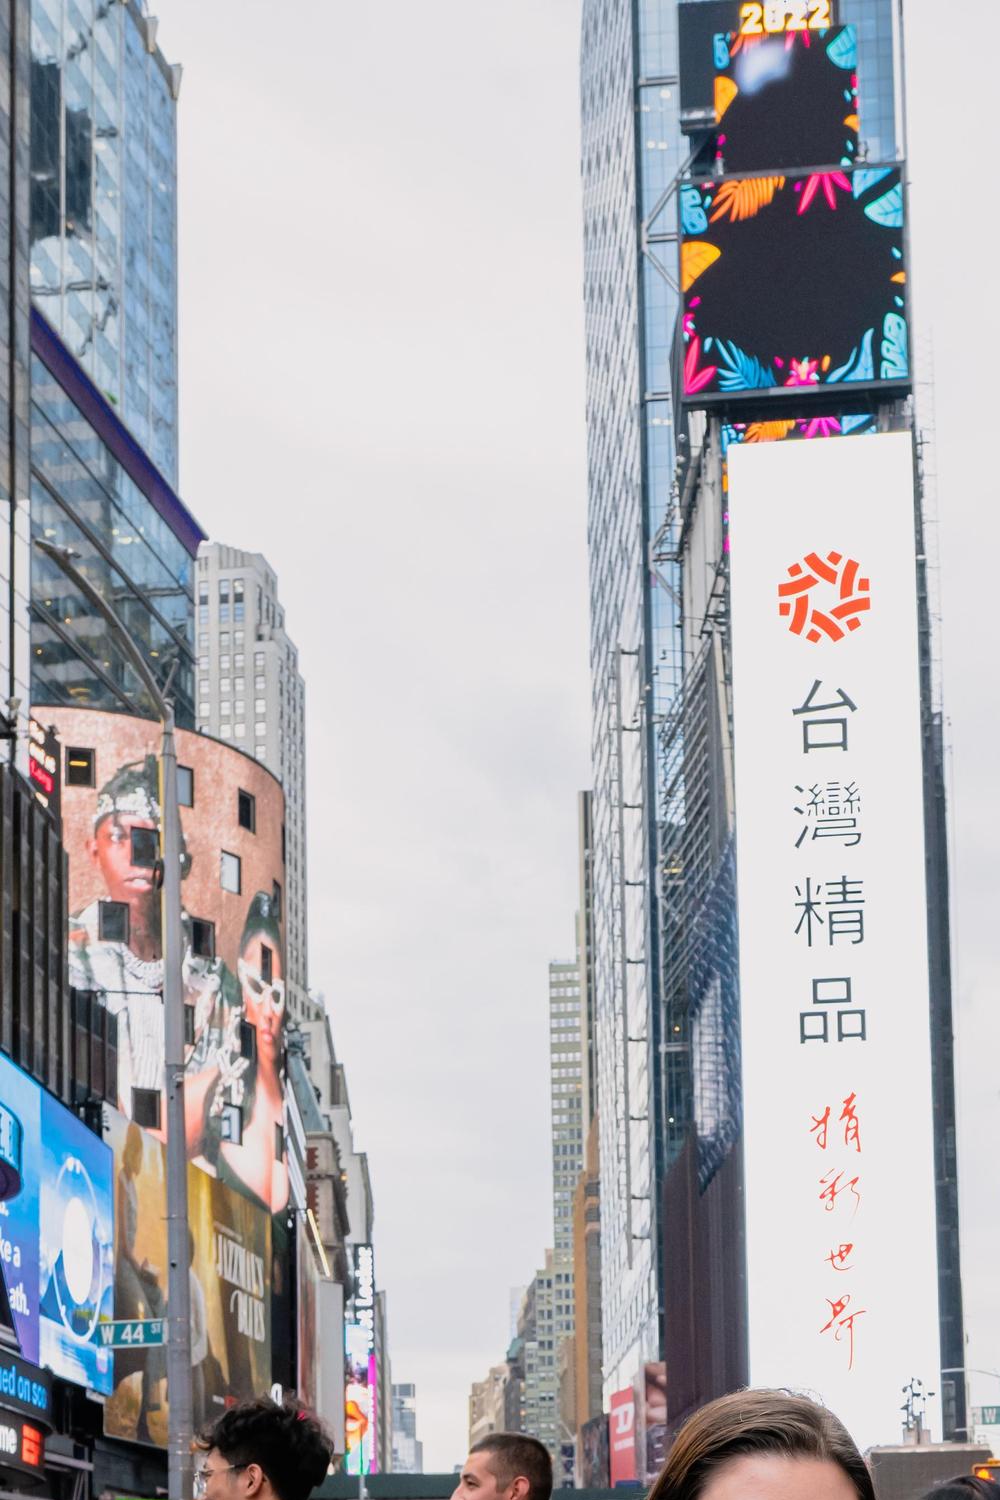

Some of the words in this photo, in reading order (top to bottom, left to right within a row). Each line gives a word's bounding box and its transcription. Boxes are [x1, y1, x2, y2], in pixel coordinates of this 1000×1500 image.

[739, 0, 830, 34] 2022
[792, 679, 867, 1045] 台灣精品
[100, 1325, 115, 1345] W
[120, 1324, 144, 1344] 44
[151, 1322, 161, 1334] ST
[984, 1408, 996, 1423] W
